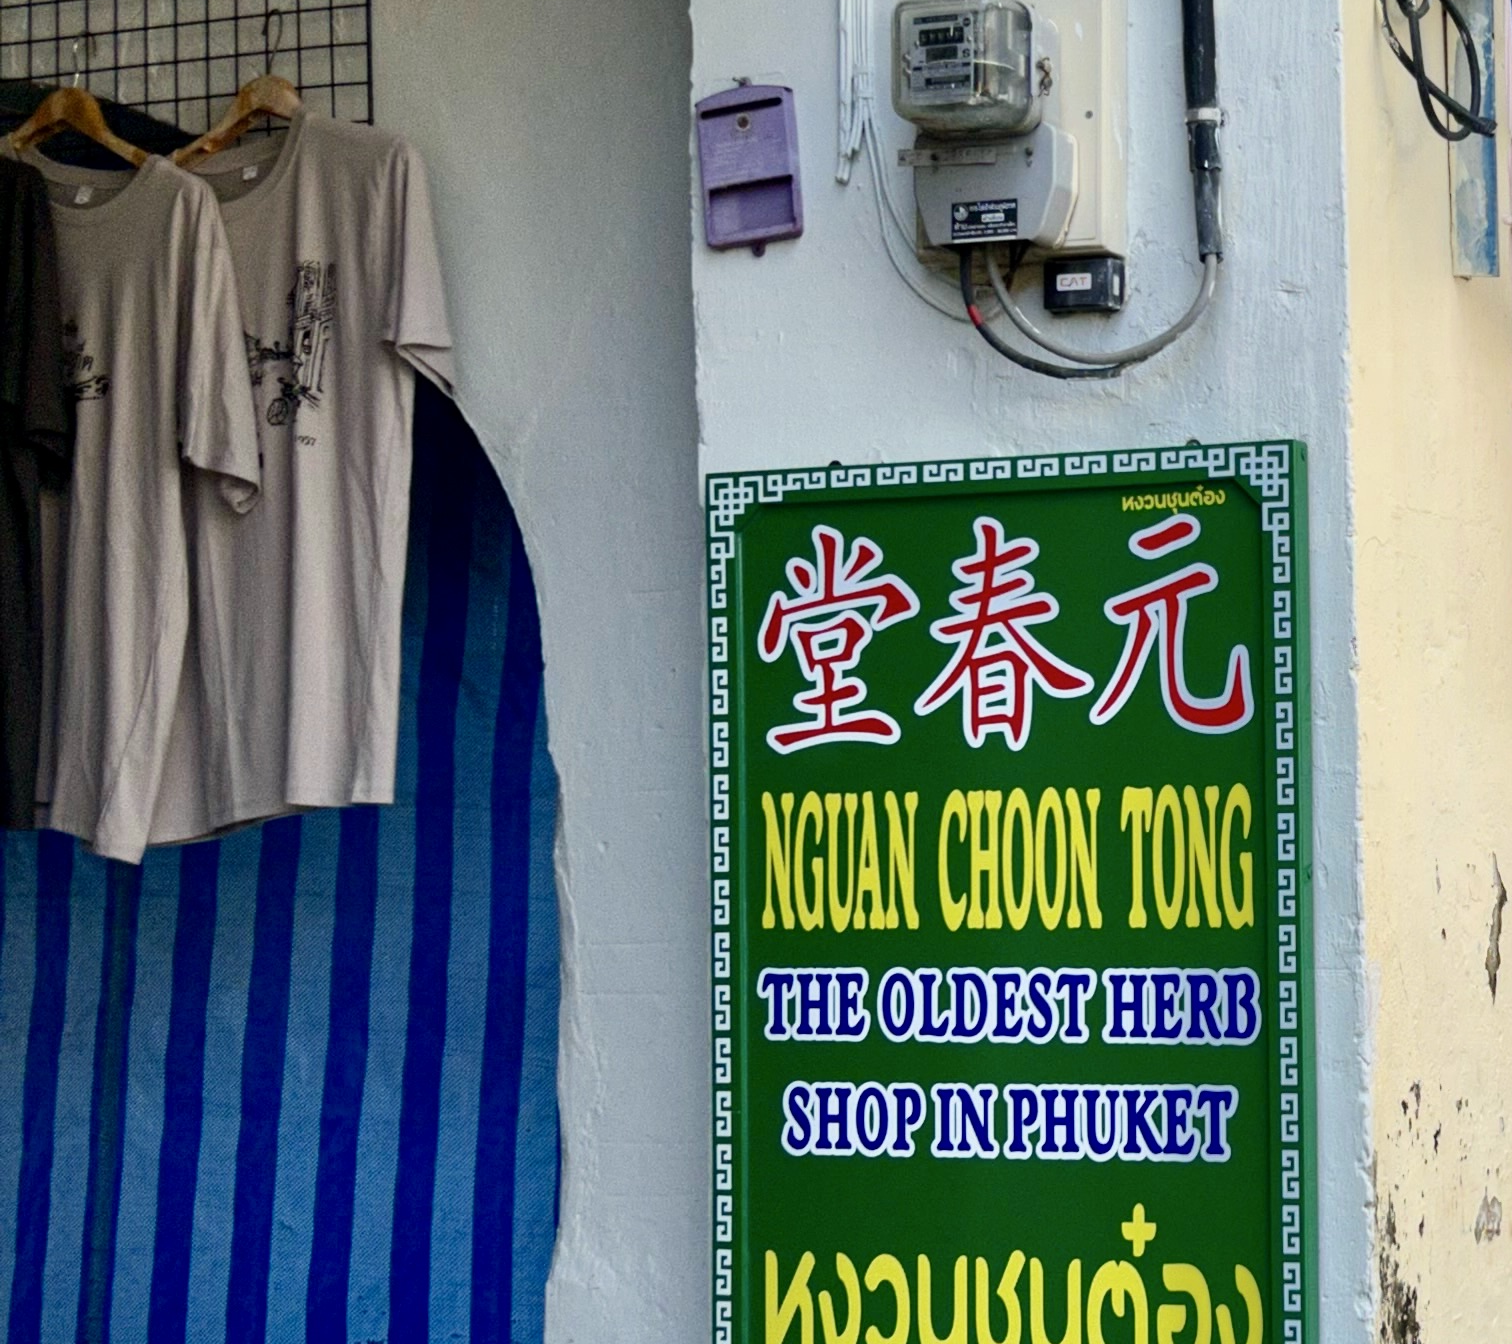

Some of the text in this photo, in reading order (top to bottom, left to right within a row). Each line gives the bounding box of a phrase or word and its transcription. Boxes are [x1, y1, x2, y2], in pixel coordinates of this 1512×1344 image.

[1059, 276, 1088, 287] CAT
[1121, 484, 1226, 515] หงวนชุนต๋อง
[760, 783, 1254, 933] NGUAN CHOON TONG
[758, 965, 1262, 1045] THE OLDEST HERB
[782, 1081, 1238, 1162] SHOP IN PHUKET
